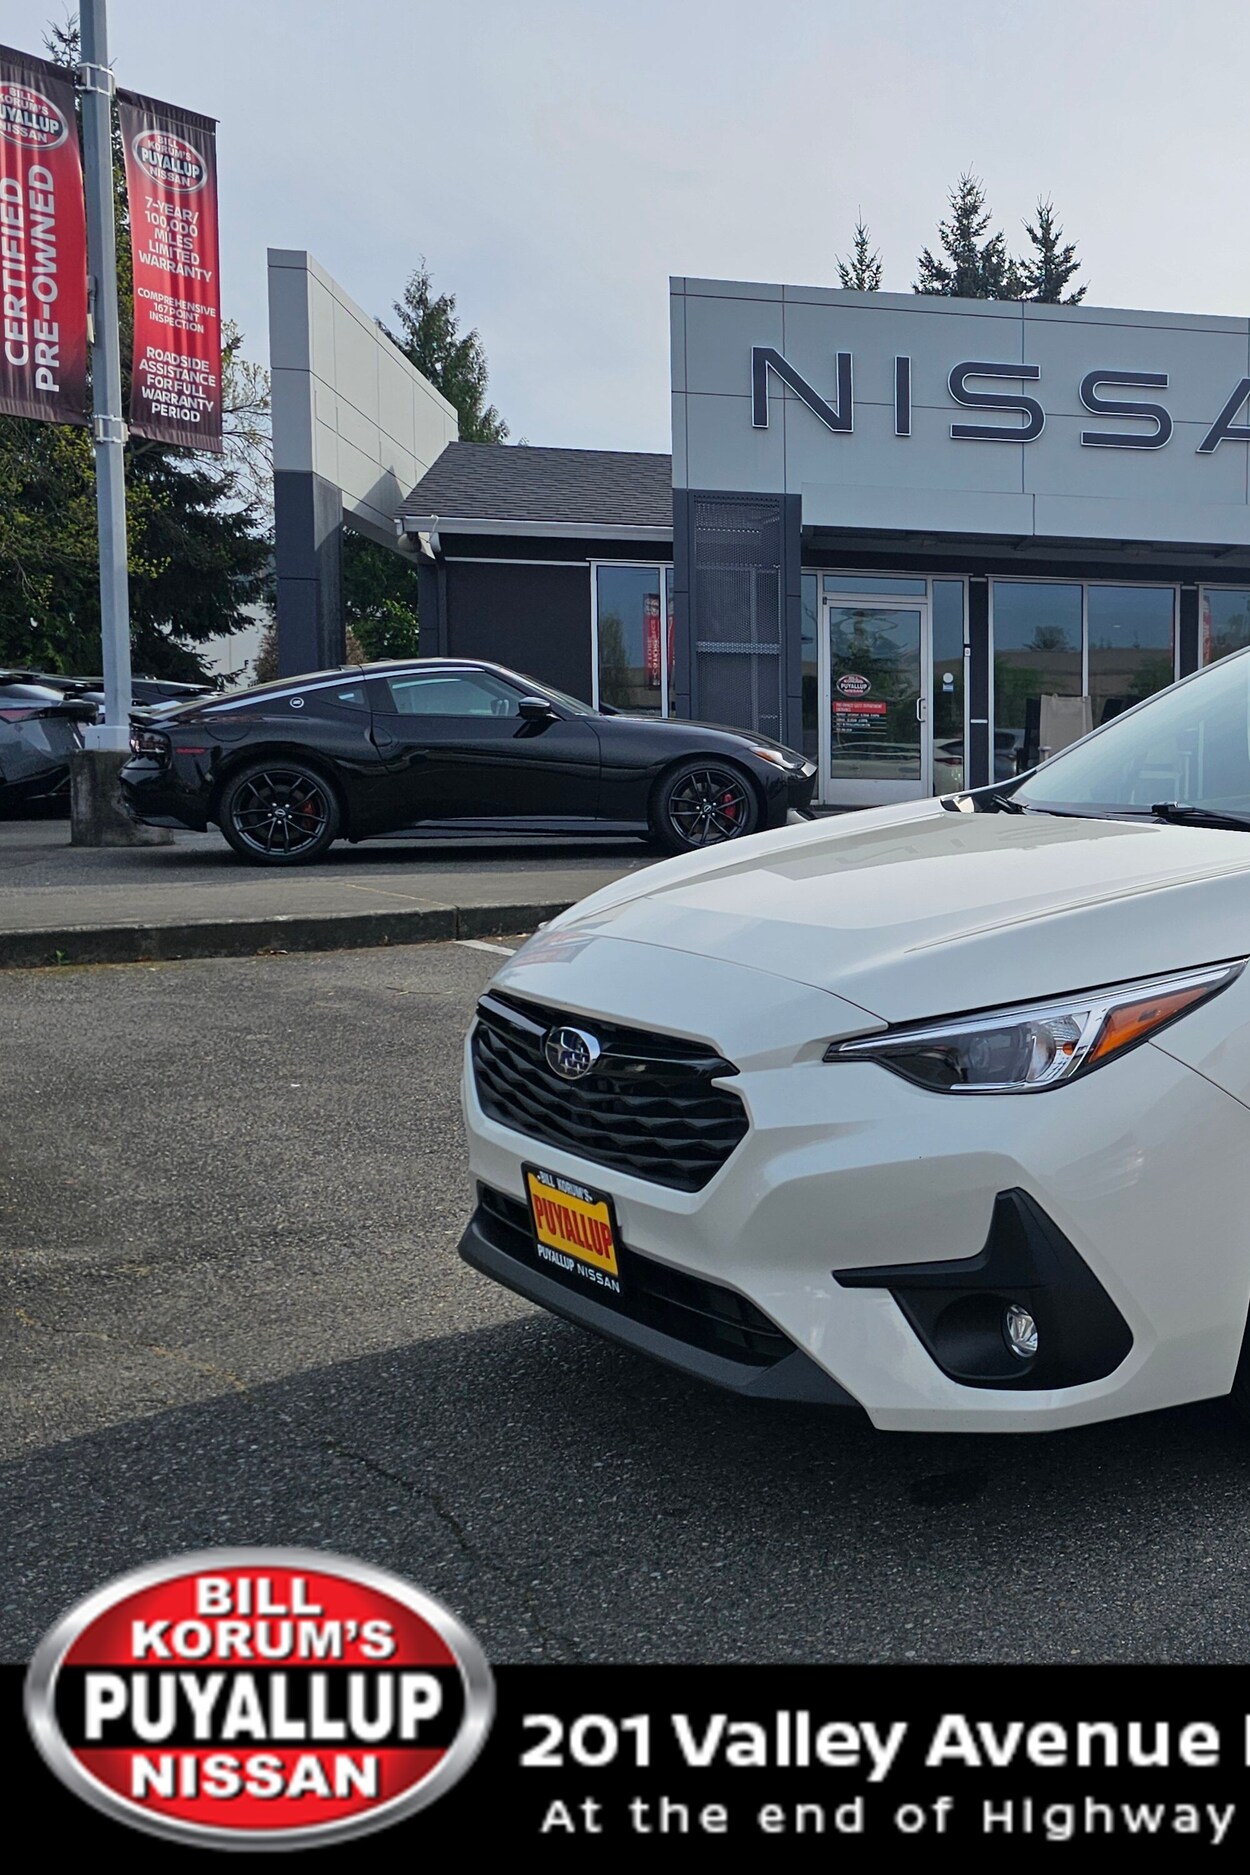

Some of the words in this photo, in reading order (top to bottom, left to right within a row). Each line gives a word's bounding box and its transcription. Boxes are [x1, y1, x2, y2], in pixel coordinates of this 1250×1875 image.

[9, 87, 35, 102] BILL
[0, 103, 60, 134] UYALLUP
[147, 139, 192, 161] KORUM'S
[157, 135, 179, 149] BILL
[141, 147, 200, 179] PUYALLUP
[150, 167, 191, 187] NISSAN
[145, 196, 199, 224] 7-YEAR/
[145, 211, 198, 237] 100,000
[154, 228, 193, 250] MILES
[148, 240, 200, 266] LIMITED
[0, 177, 29, 367] CERTIFIED
[28, 164, 60, 393] PRE-OWNED
[138, 250, 212, 283] WARRANTY
[137, 287, 216, 317] COMPREHENSIVE
[153, 302, 169, 314] 167
[169, 306, 200, 322] POINT
[149, 311, 204, 333] INSPECTION
[146, 346, 210, 372] ROADSIDE
[139, 358, 216, 387] ASSISTANCE
[147, 373, 173, 391] FOR
[174, 381, 207, 398] FULL
[141, 386, 214, 412] WARRANTY
[151, 402, 200, 422] PERIOD
[539, 1170, 555, 1188] BILL
[556, 1177, 590, 1202] KORUM'S
[532, 1193, 613, 1260] PUYALLUP
[537, 1243, 575, 1272] PUYALLUP
[577, 1263, 621, 1294] NISSAN
